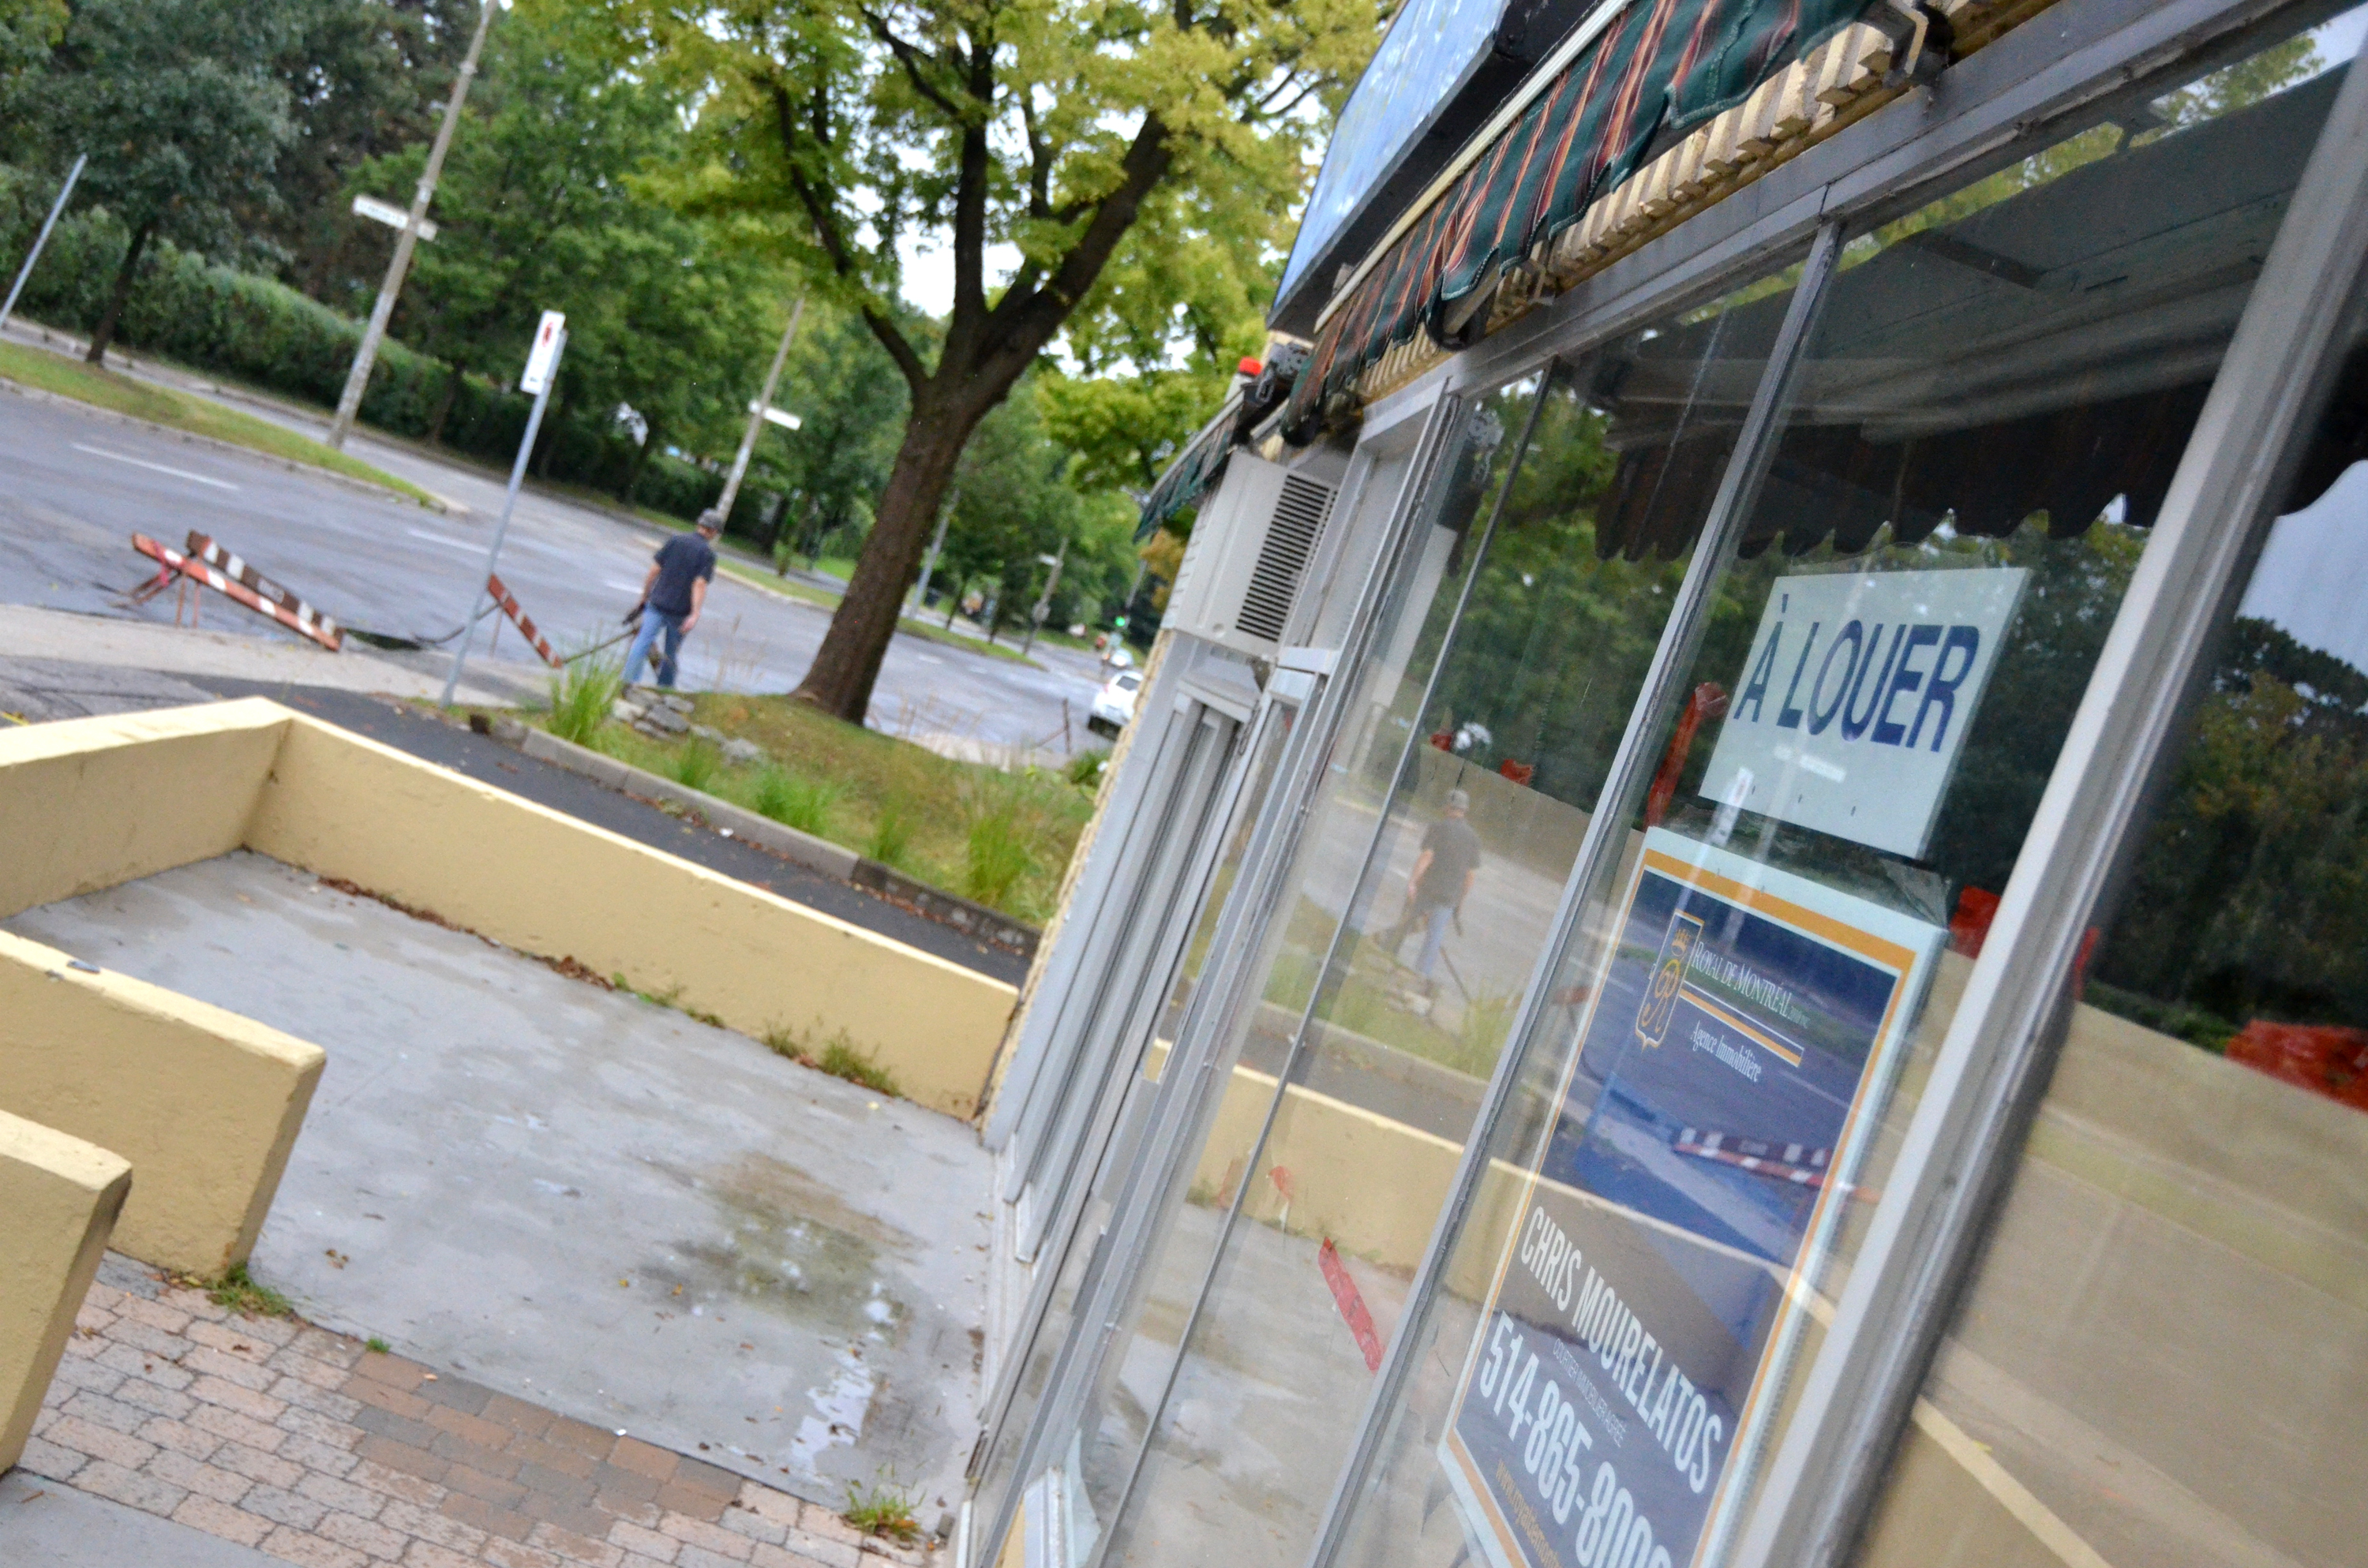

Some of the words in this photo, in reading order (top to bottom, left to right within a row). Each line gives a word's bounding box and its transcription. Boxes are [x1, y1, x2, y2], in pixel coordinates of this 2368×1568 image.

[1733, 593, 1789, 723] À
[1776, 619, 1980, 753] LOUER
[1691, 941, 1724, 981] ROYAL
[1721, 960, 1738, 987] DE
[1690, 1020, 1718, 1054] Agence
[1715, 1035, 1762, 1083] Immobilière
[1521, 1206, 1582, 1312] CHRIS
[1571, 1266, 1722, 1494] MOURELATOS
[1479, 1310, 1673, 1568] 514-865-80
